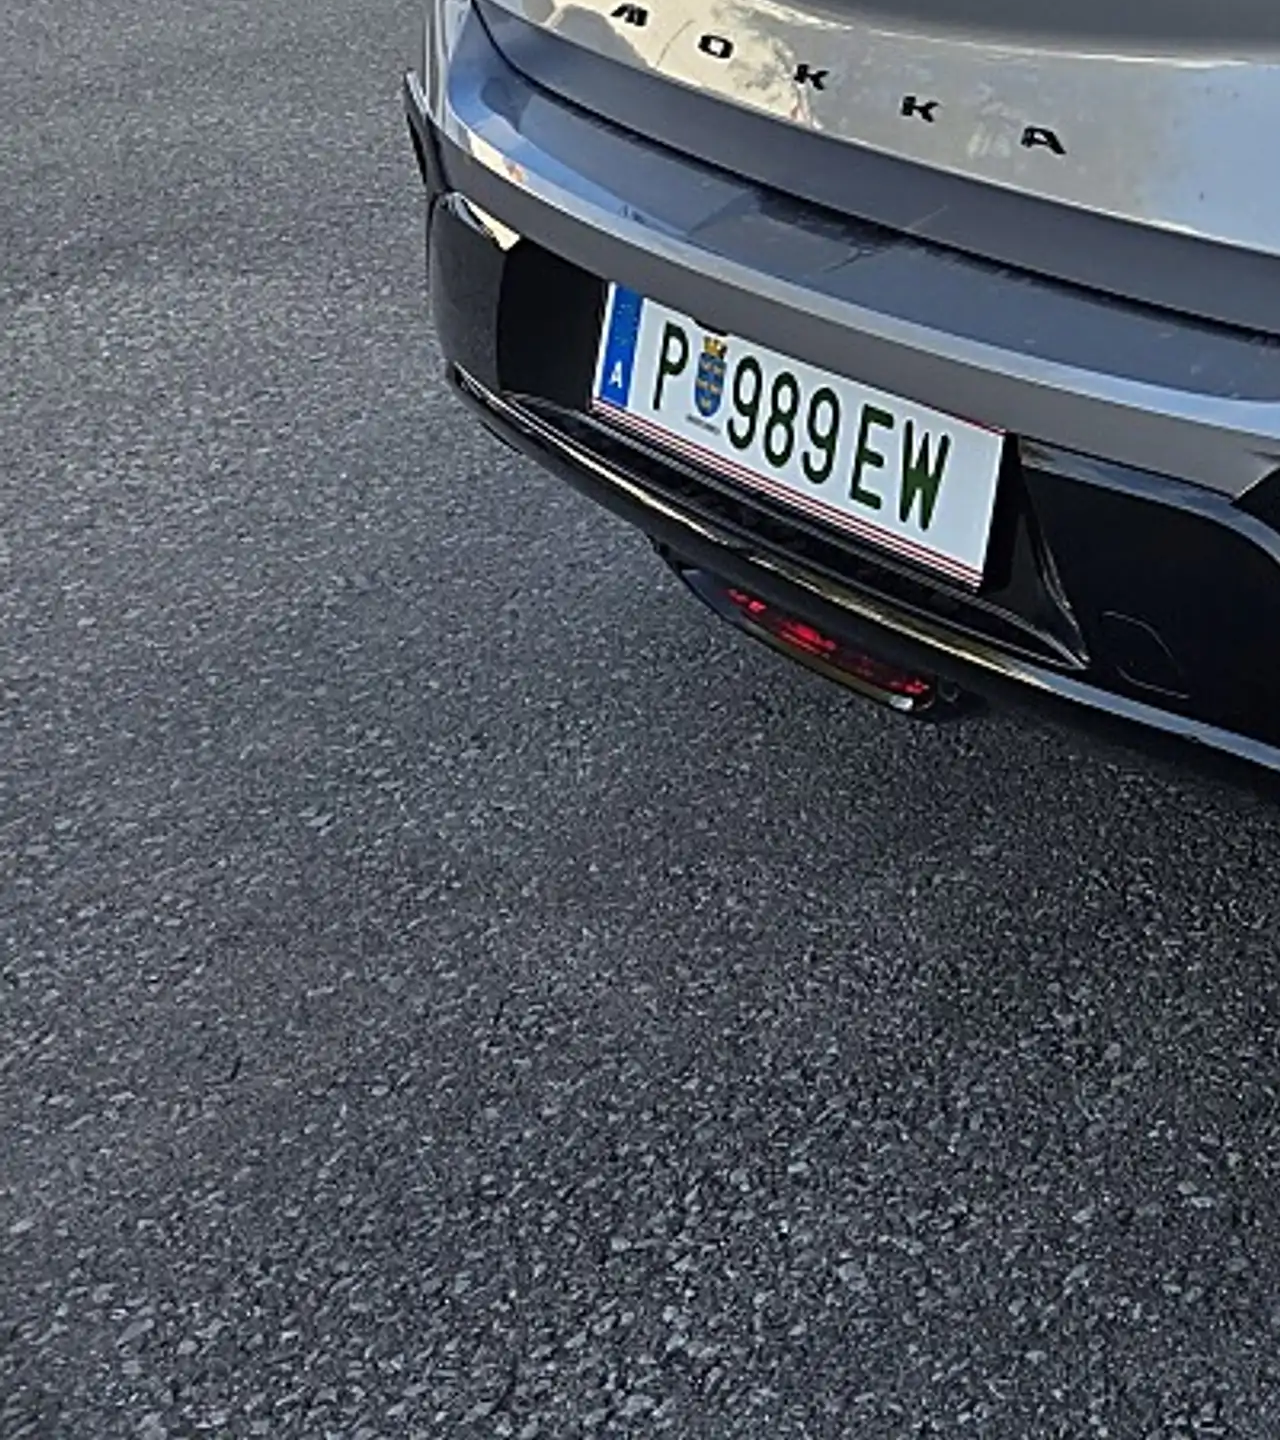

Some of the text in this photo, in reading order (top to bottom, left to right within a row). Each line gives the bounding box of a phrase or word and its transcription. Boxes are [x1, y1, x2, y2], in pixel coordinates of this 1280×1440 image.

[610, 2, 1067, 155] MOKKA
[608, 360, 623, 389] A
[652, 320, 950, 533] P 989 EW
